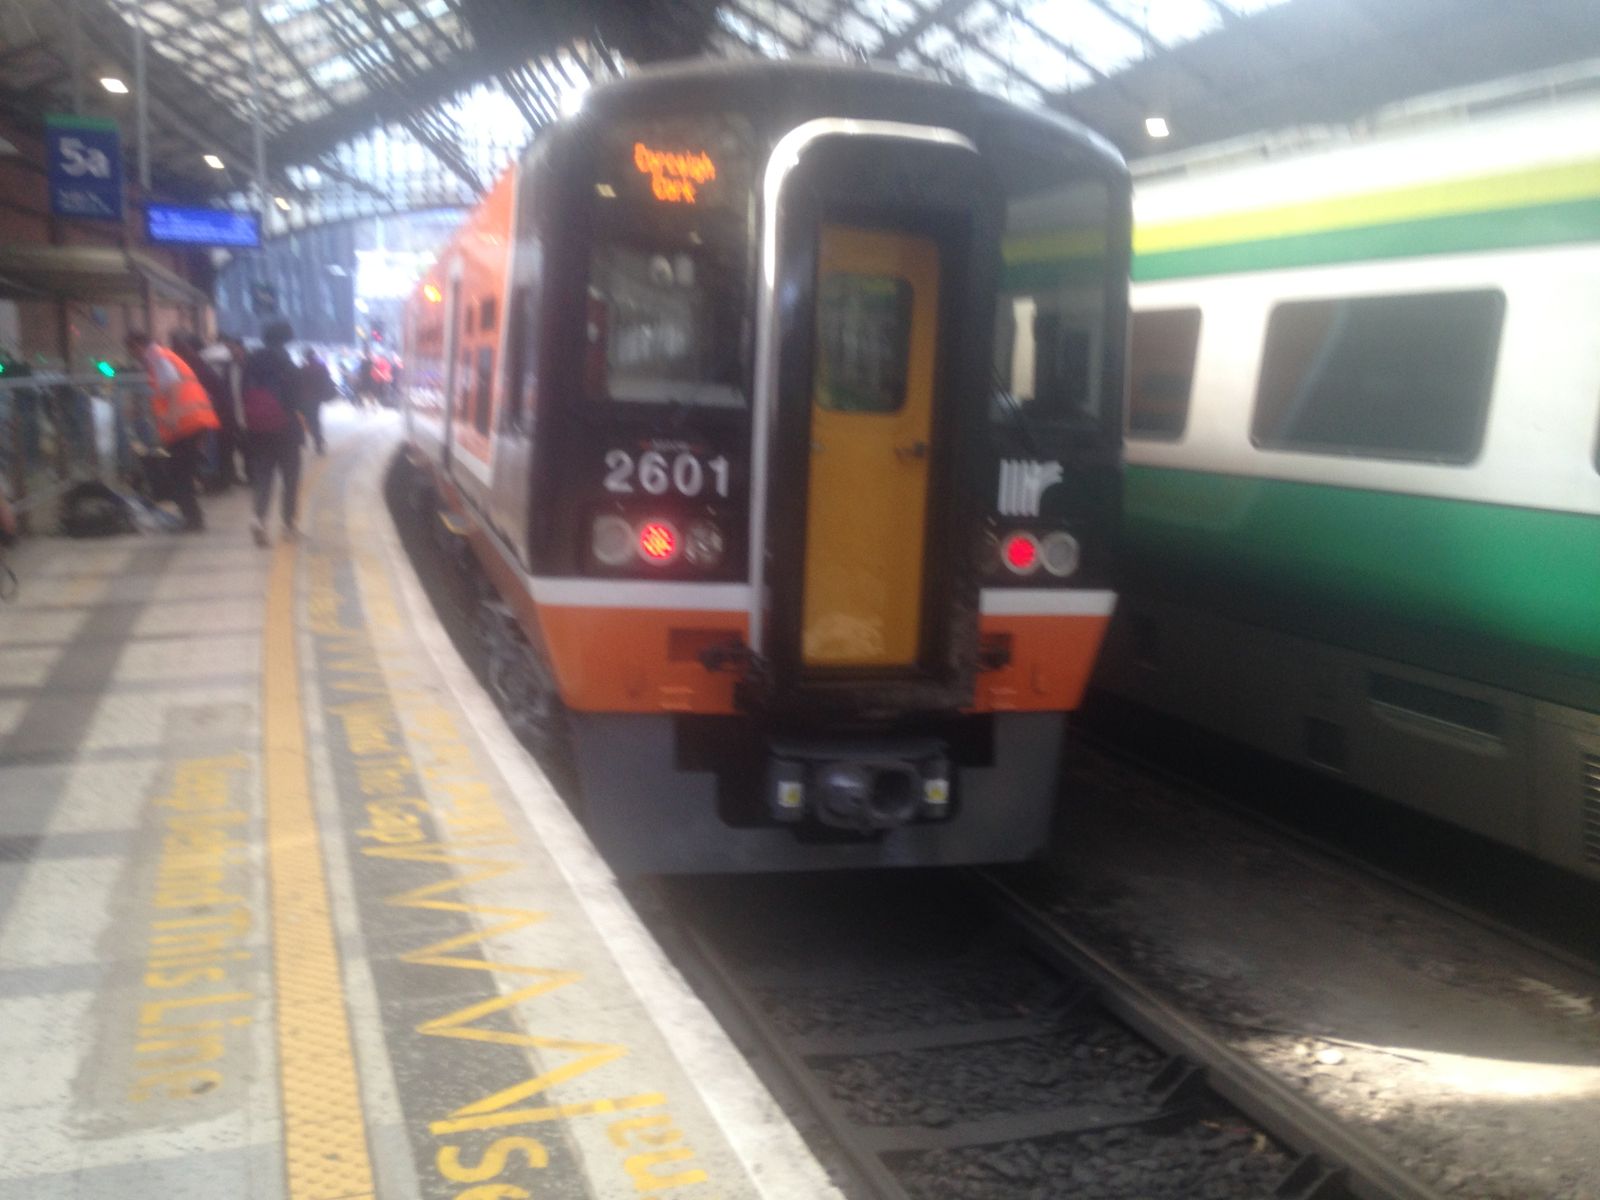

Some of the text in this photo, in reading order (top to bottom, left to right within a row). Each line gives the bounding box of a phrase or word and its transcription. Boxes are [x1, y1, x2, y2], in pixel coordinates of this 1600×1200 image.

[602, 449, 730, 498] 2601
[356, 798, 430, 843] Gap
[144, 908, 253, 989] This
[128, 991, 254, 1104] Line
